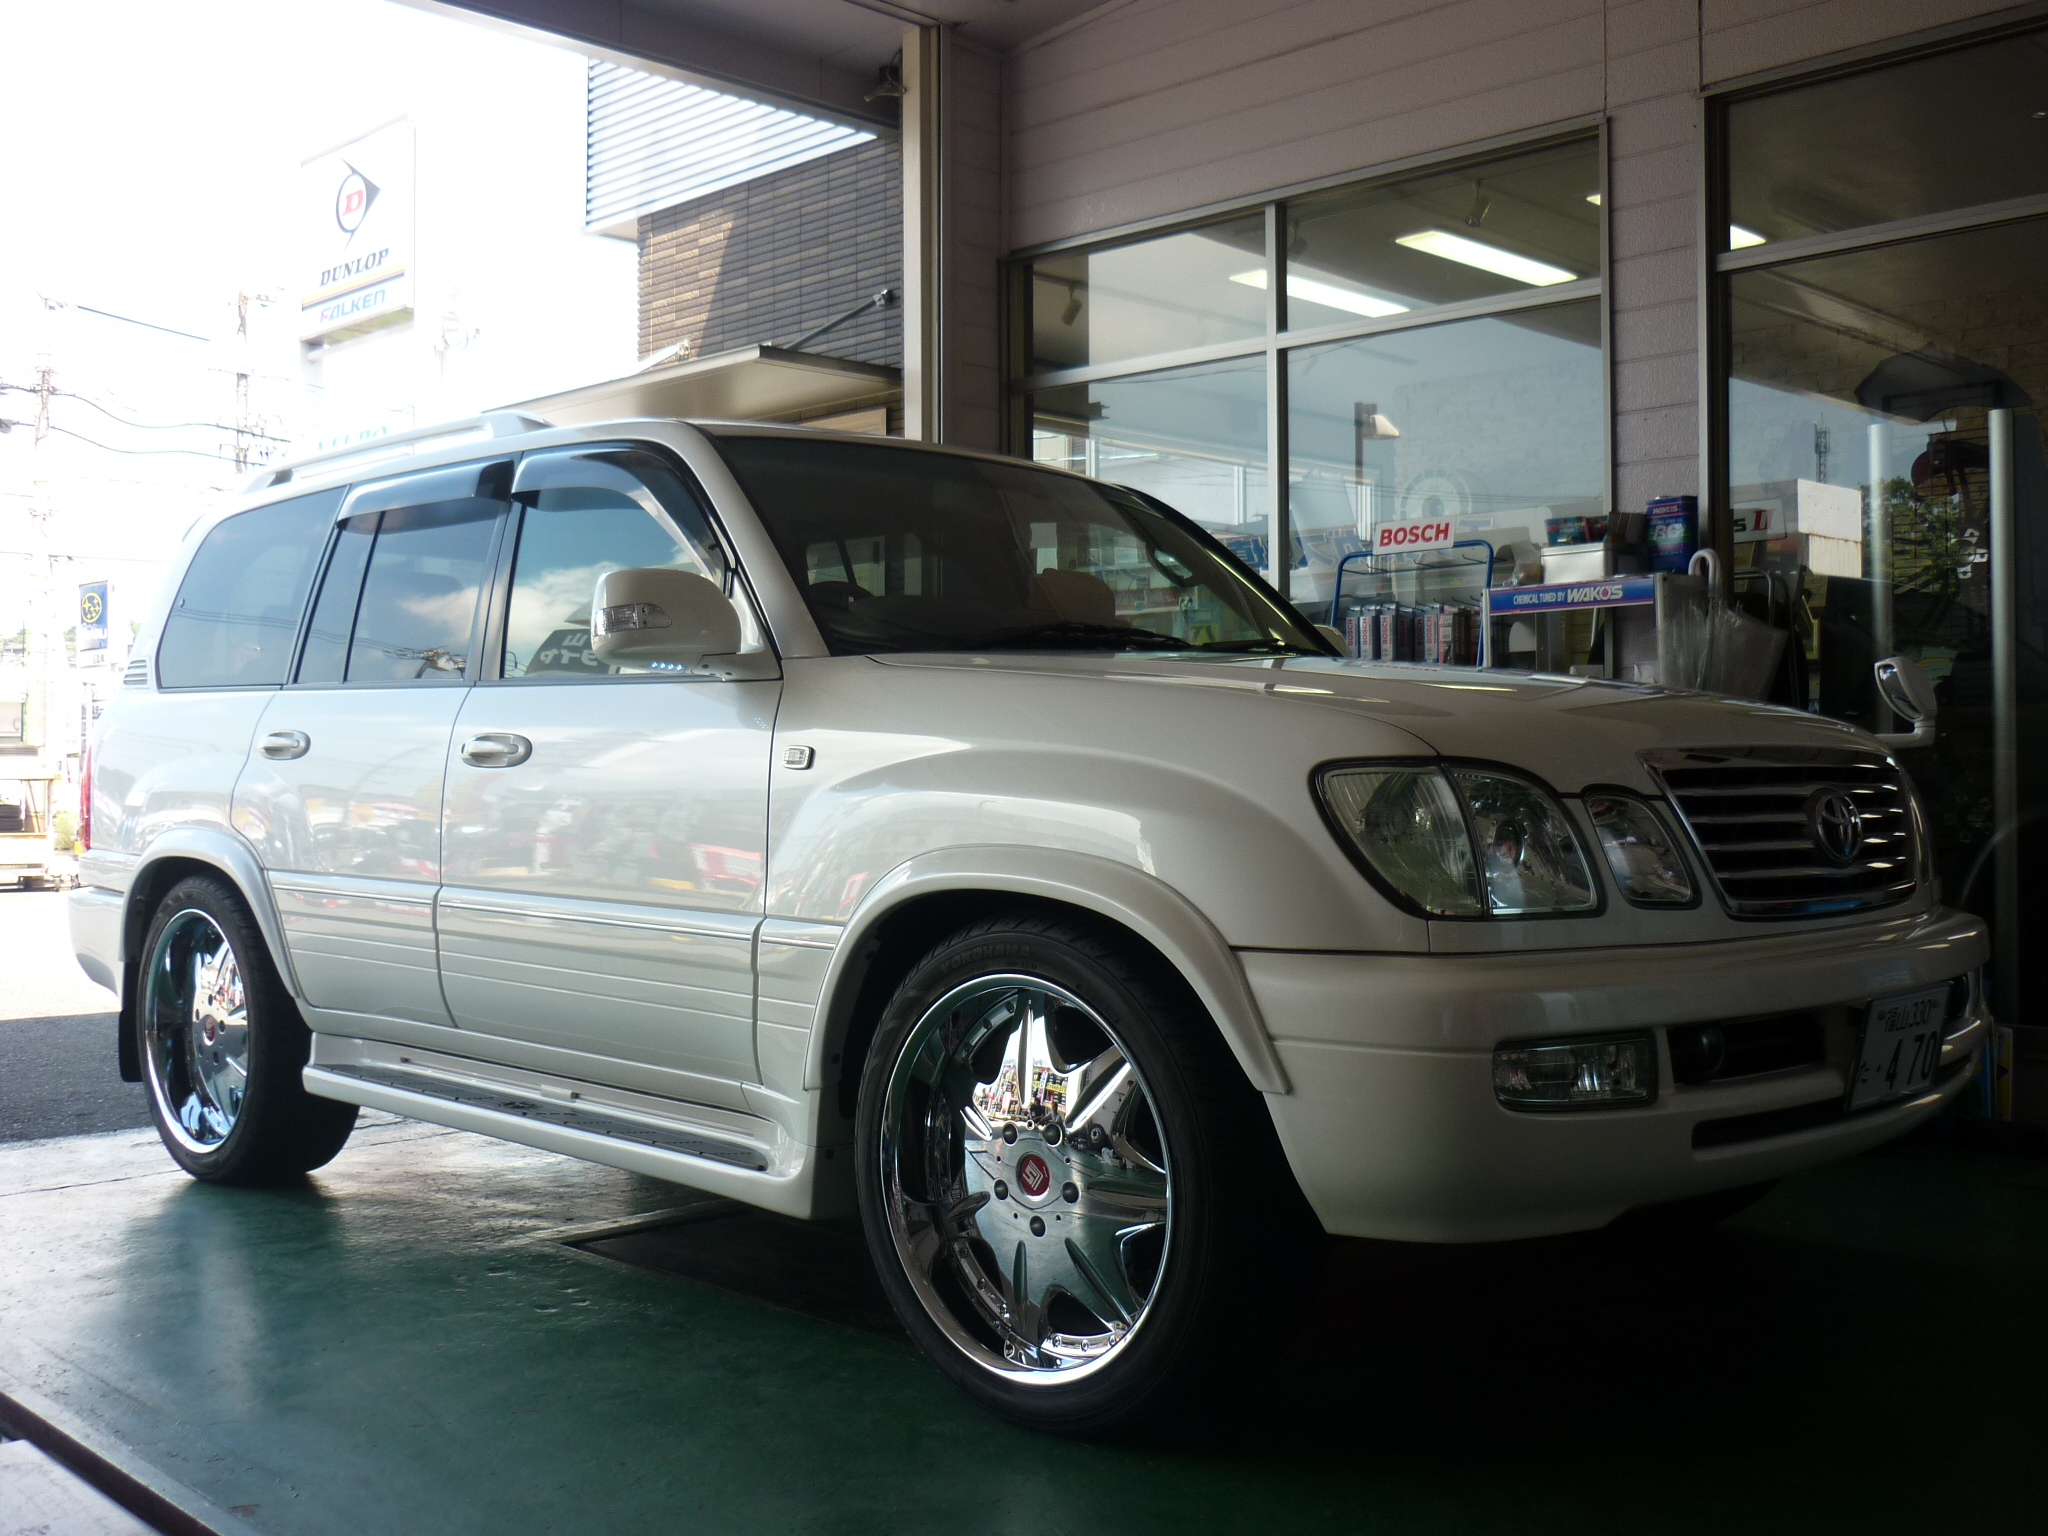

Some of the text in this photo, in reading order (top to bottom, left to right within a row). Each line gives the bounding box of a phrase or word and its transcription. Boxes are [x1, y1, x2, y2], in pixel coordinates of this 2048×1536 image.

[342, 189, 364, 216] D
[319, 248, 390, 288] DUNLOP
[320, 289, 386, 324] FALKEN
[1379, 522, 1450, 547] BOSCH
[1513, 591, 1539, 605] CHEMICAL
[1539, 591, 1557, 604] TUNED
[1557, 592, 1565, 602] BY
[941, 945, 1031, 973] YOKOHAMA
